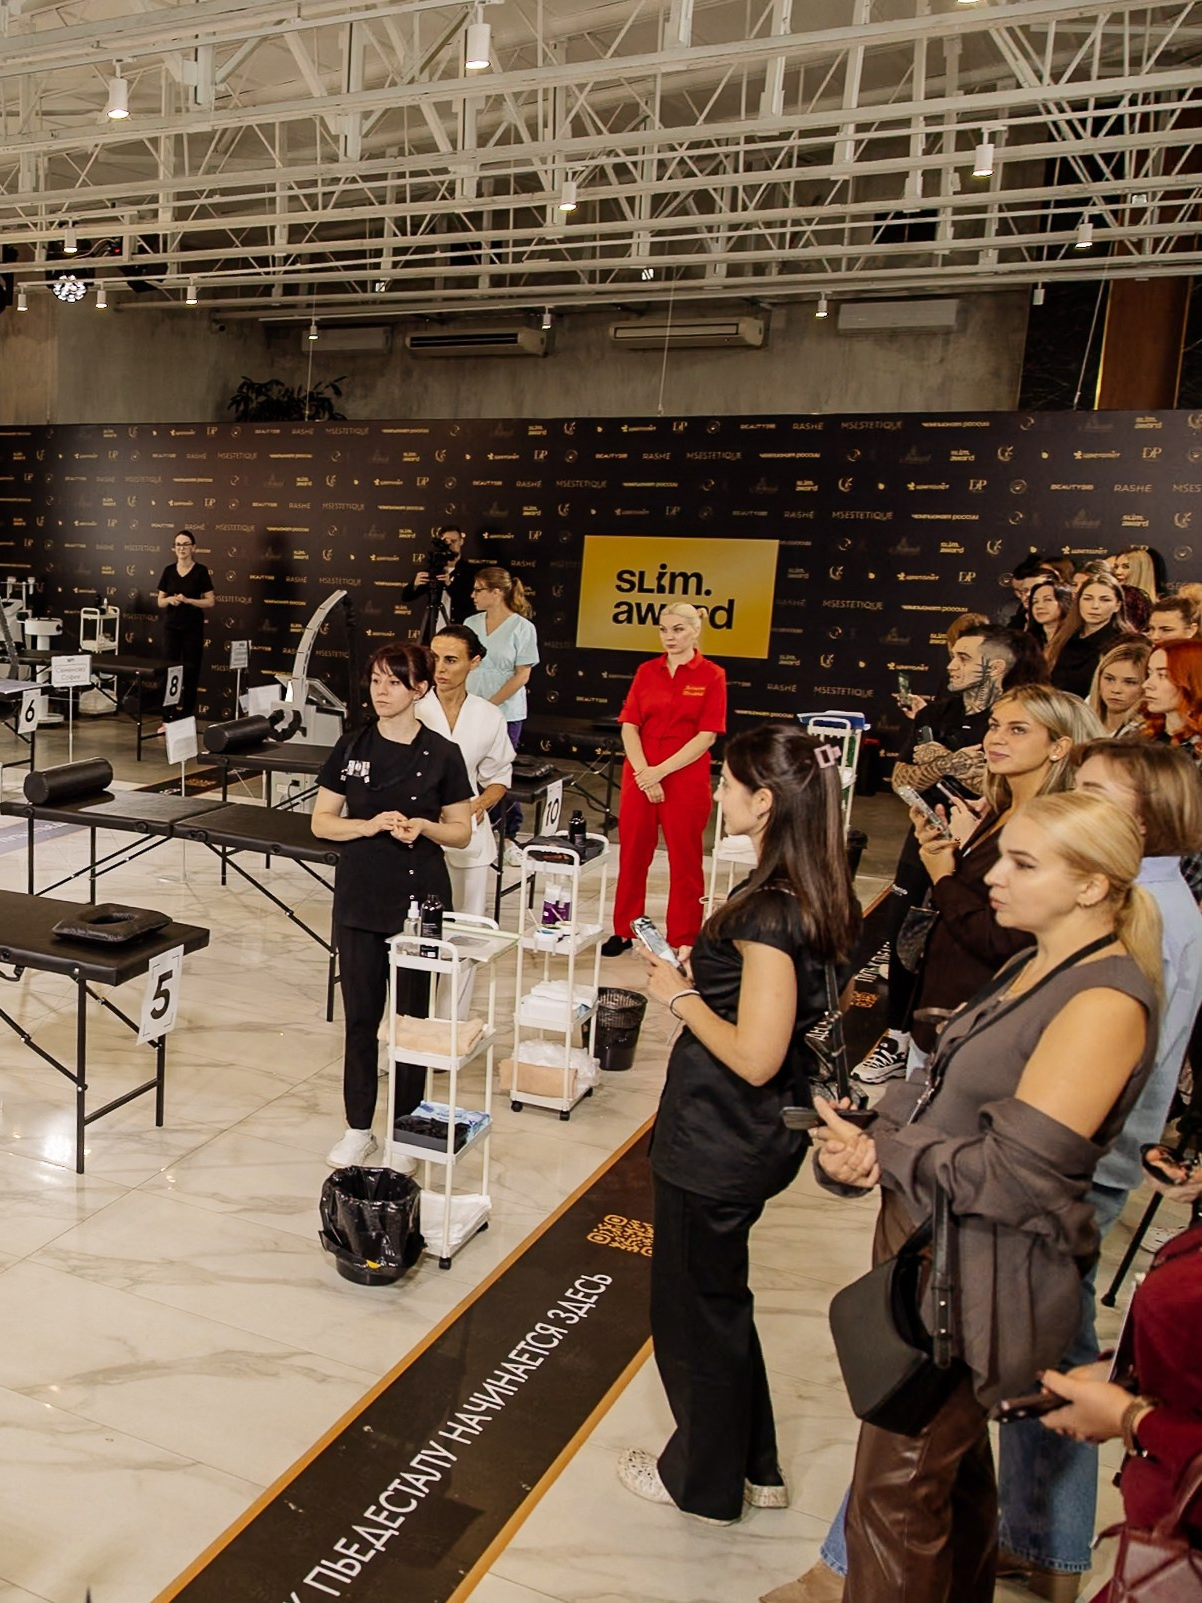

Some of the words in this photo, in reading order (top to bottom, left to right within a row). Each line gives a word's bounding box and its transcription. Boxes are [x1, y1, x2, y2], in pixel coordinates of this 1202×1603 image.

[612, 599, 735, 630] awd
[823, 600, 883, 610] MSESTETIQUE
[170, 675, 179, 697] 8
[24, 700, 35, 722] 6
[545, 797, 561, 826] 10
[150, 970, 173, 1020] 5
[303, 1439, 458, 1597] ПЬЕДЕСТАЛУ
[438, 1322, 568, 1446] НАЧИНАЕТСЯ
[546, 1272, 613, 1327] ЗДЕСЬ
